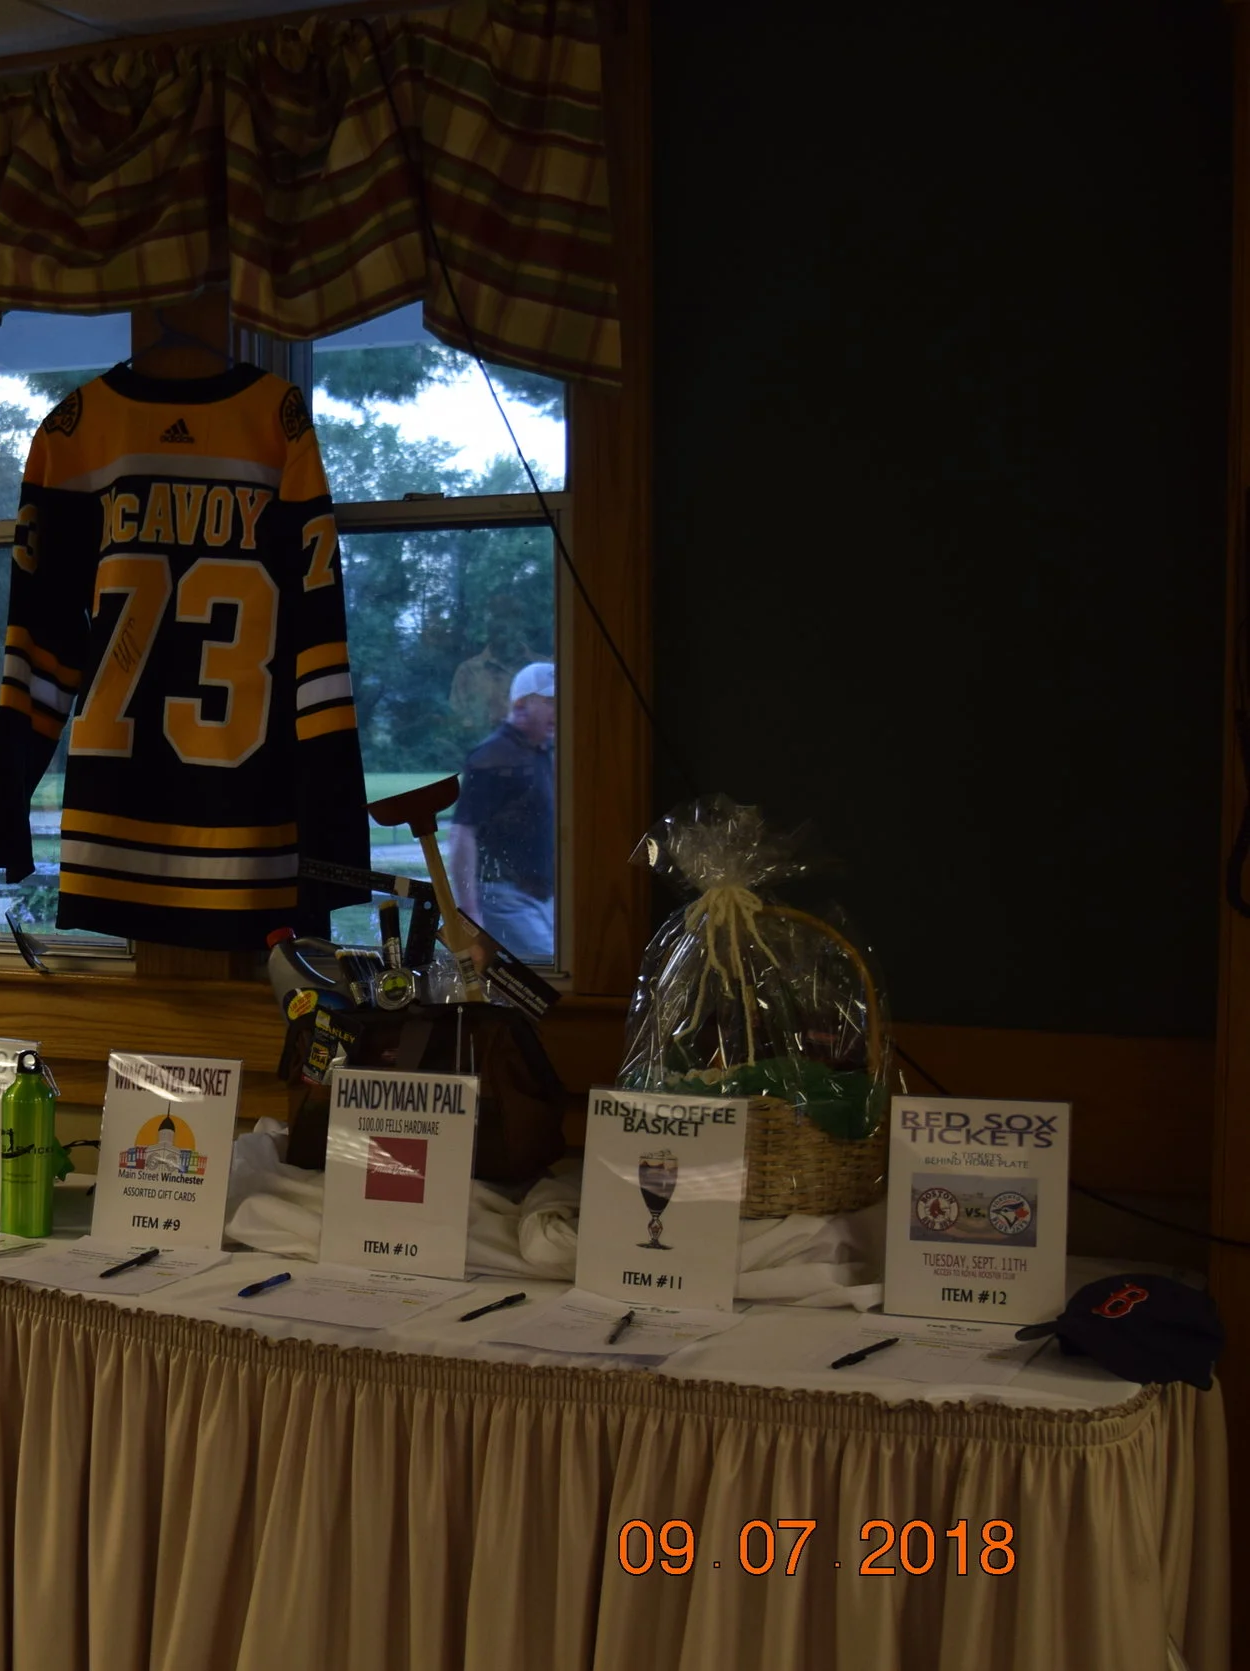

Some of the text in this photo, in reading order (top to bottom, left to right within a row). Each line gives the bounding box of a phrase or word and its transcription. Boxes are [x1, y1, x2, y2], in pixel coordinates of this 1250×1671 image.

[301, 513, 337, 593] 7
[68, 553, 281, 768] 73
[187, 1067, 232, 1097] BASKET
[337, 1077, 466, 1115] HANDYMAN PAIL
[593, 1099, 737, 1125] IRISH COFFEE
[901, 1110, 1058, 1133] RED SOX
[358, 1116, 440, 1136] $100.00 FELLS HARDWARE
[623, 1117, 701, 1137] BASKET
[902, 1126, 1054, 1148] TICKETS
[924, 1156, 1029, 1169] BEHIND HOME PLATE
[961, 1152, 1002, 1161] TICKETS
[118, 1168, 204, 1185] Main Street Winchester
[123, 1186, 197, 1202] ASSORTED GIFT CARDS
[132, 1215, 181, 1231] ITEM #9
[363, 1240, 418, 1257] ITEM #10
[923, 1252, 1028, 1272] TUESDAY, SEPT. 11TH
[622, 1271, 682, 1290] ITEM #11
[941, 1287, 1007, 1305] ITEM #12
